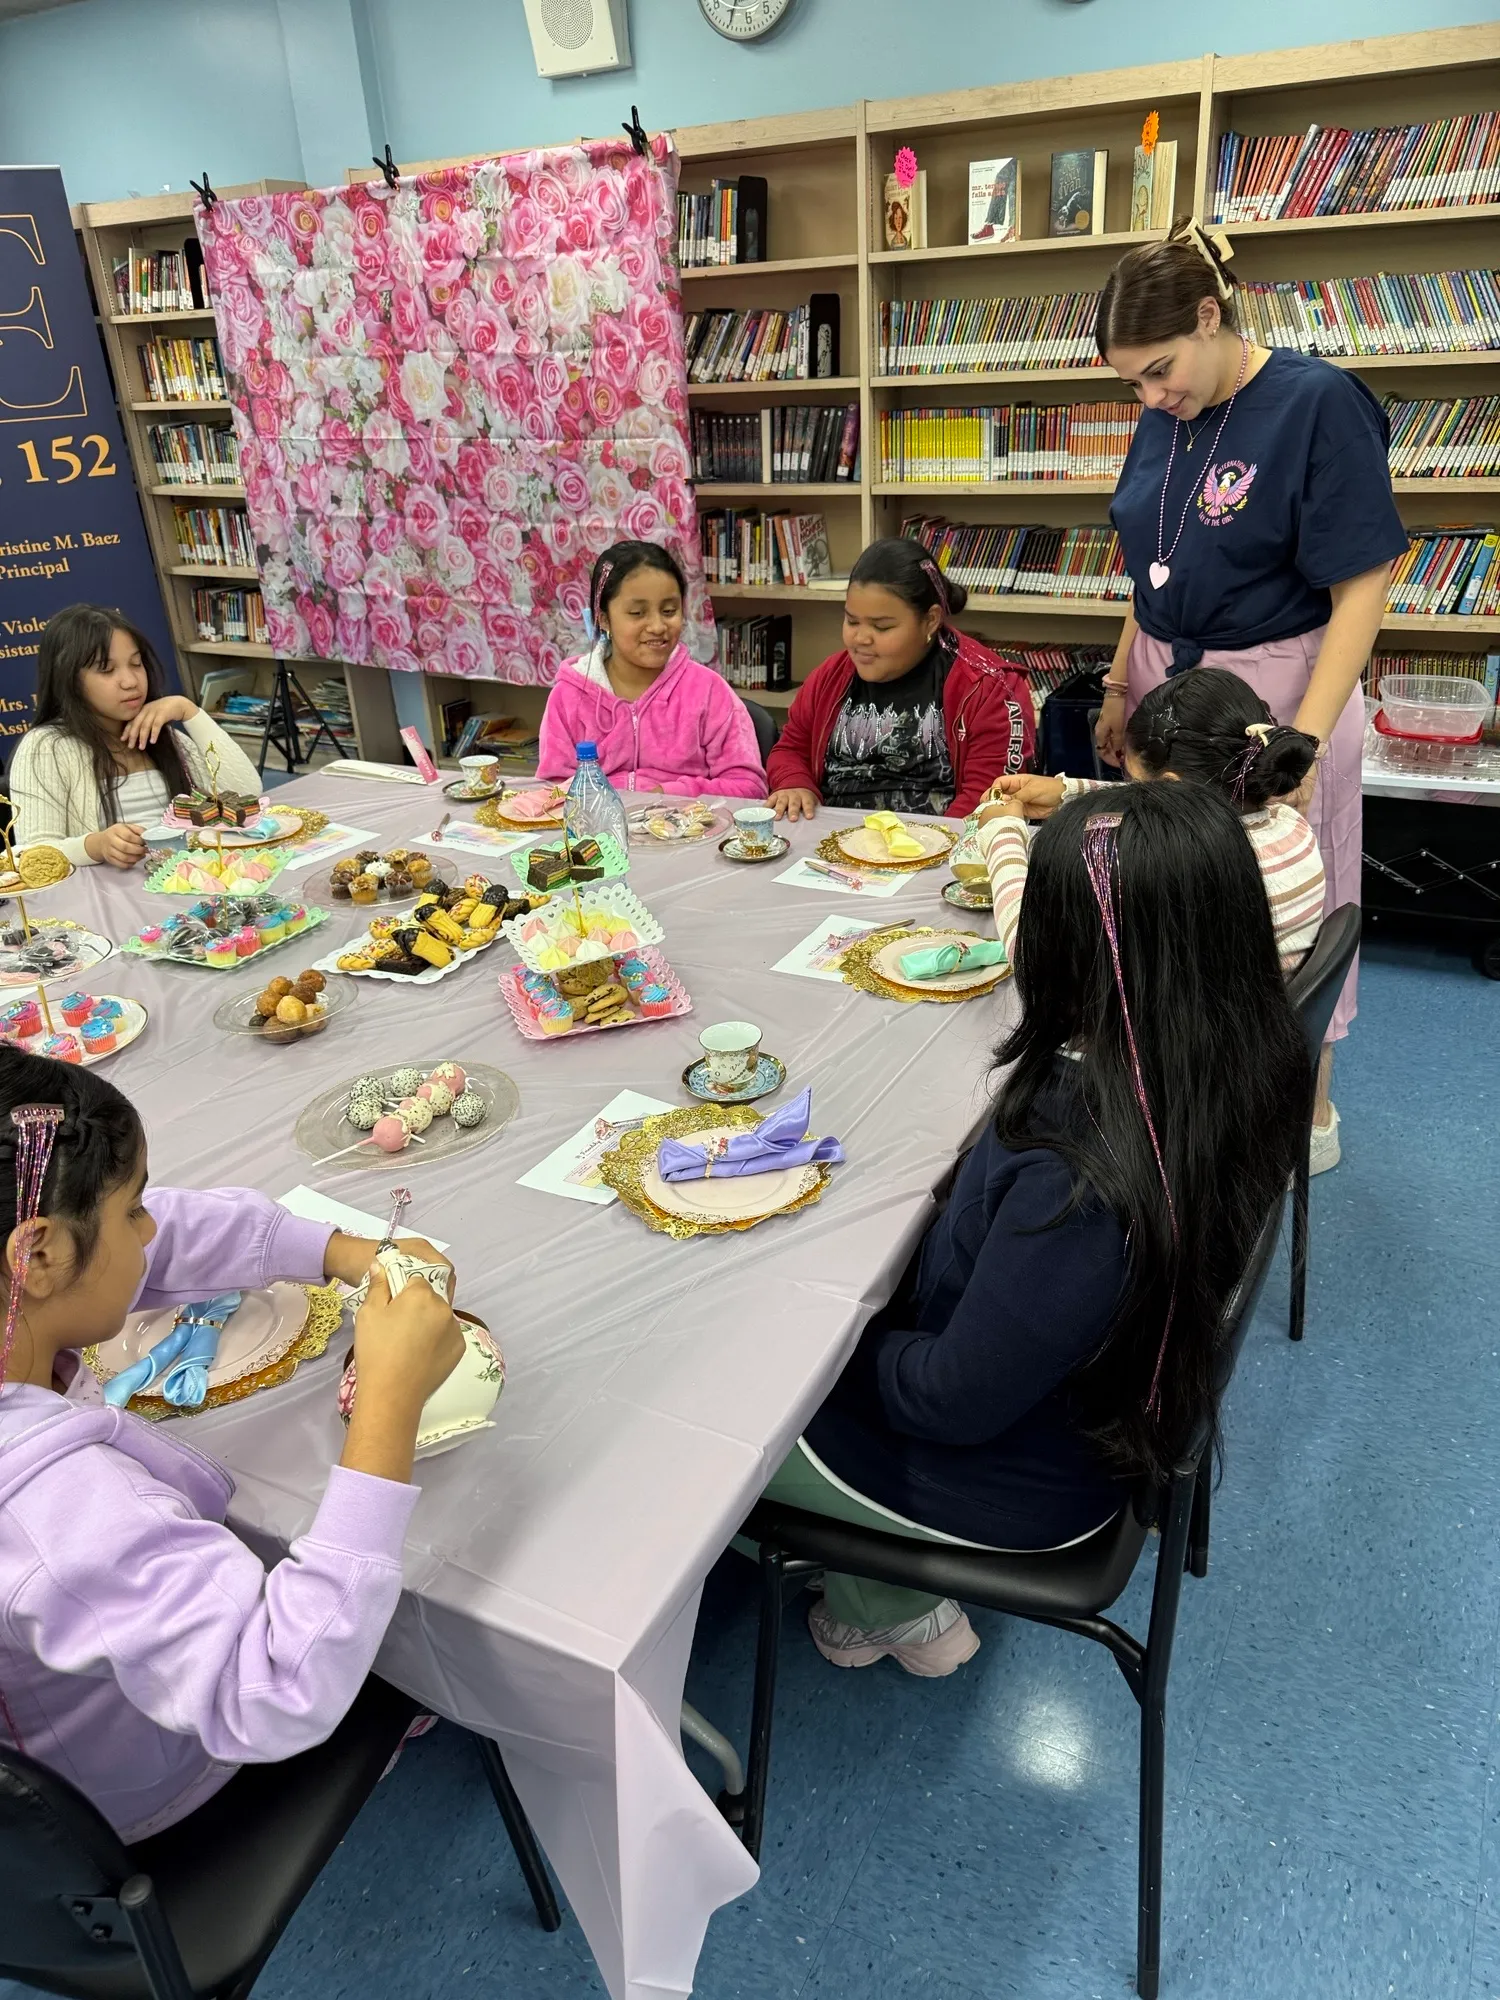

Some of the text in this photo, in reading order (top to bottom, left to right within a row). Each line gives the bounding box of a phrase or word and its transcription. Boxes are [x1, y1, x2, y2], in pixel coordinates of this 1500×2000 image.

[745, 11, 753, 25] 6
[17, 433, 117, 485] 152
[53, 534, 79, 551] M.
[81, 532, 121, 547] Baez
[0, 557, 71, 580] Principal
[1, 616, 50, 636] Viole
[0, 719, 32, 737] Assi
